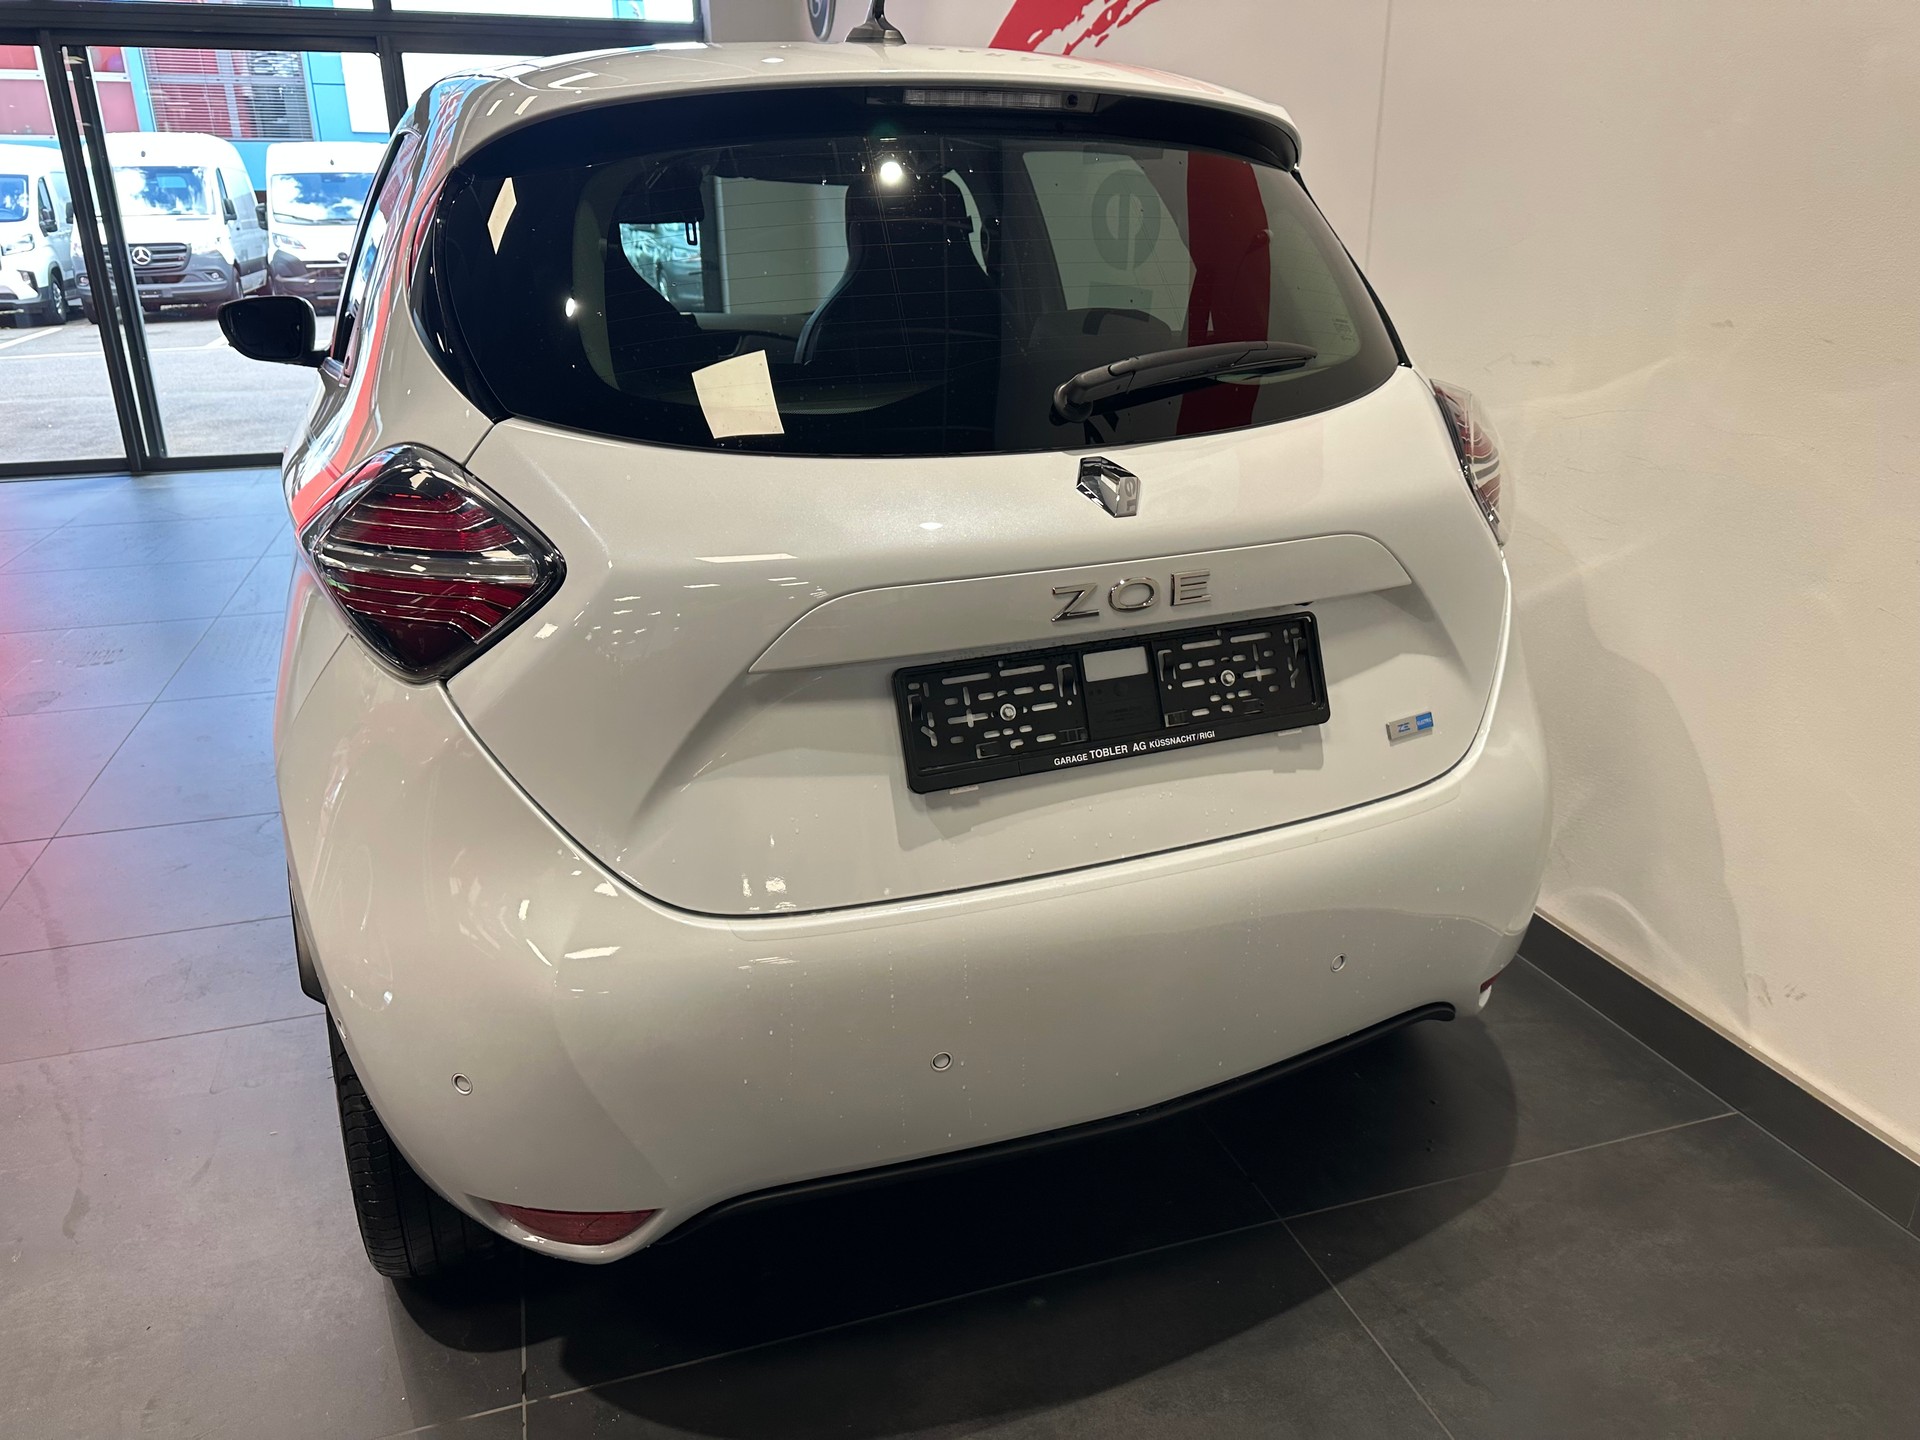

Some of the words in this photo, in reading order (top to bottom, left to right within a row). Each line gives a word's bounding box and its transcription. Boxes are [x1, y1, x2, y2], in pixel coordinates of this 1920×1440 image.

[1052, 568, 1212, 622] ZOE
[1053, 753, 1088, 766] GARAGE
[1089, 744, 1128, 759] TOBLER
[1132, 741, 1147, 752] AG
